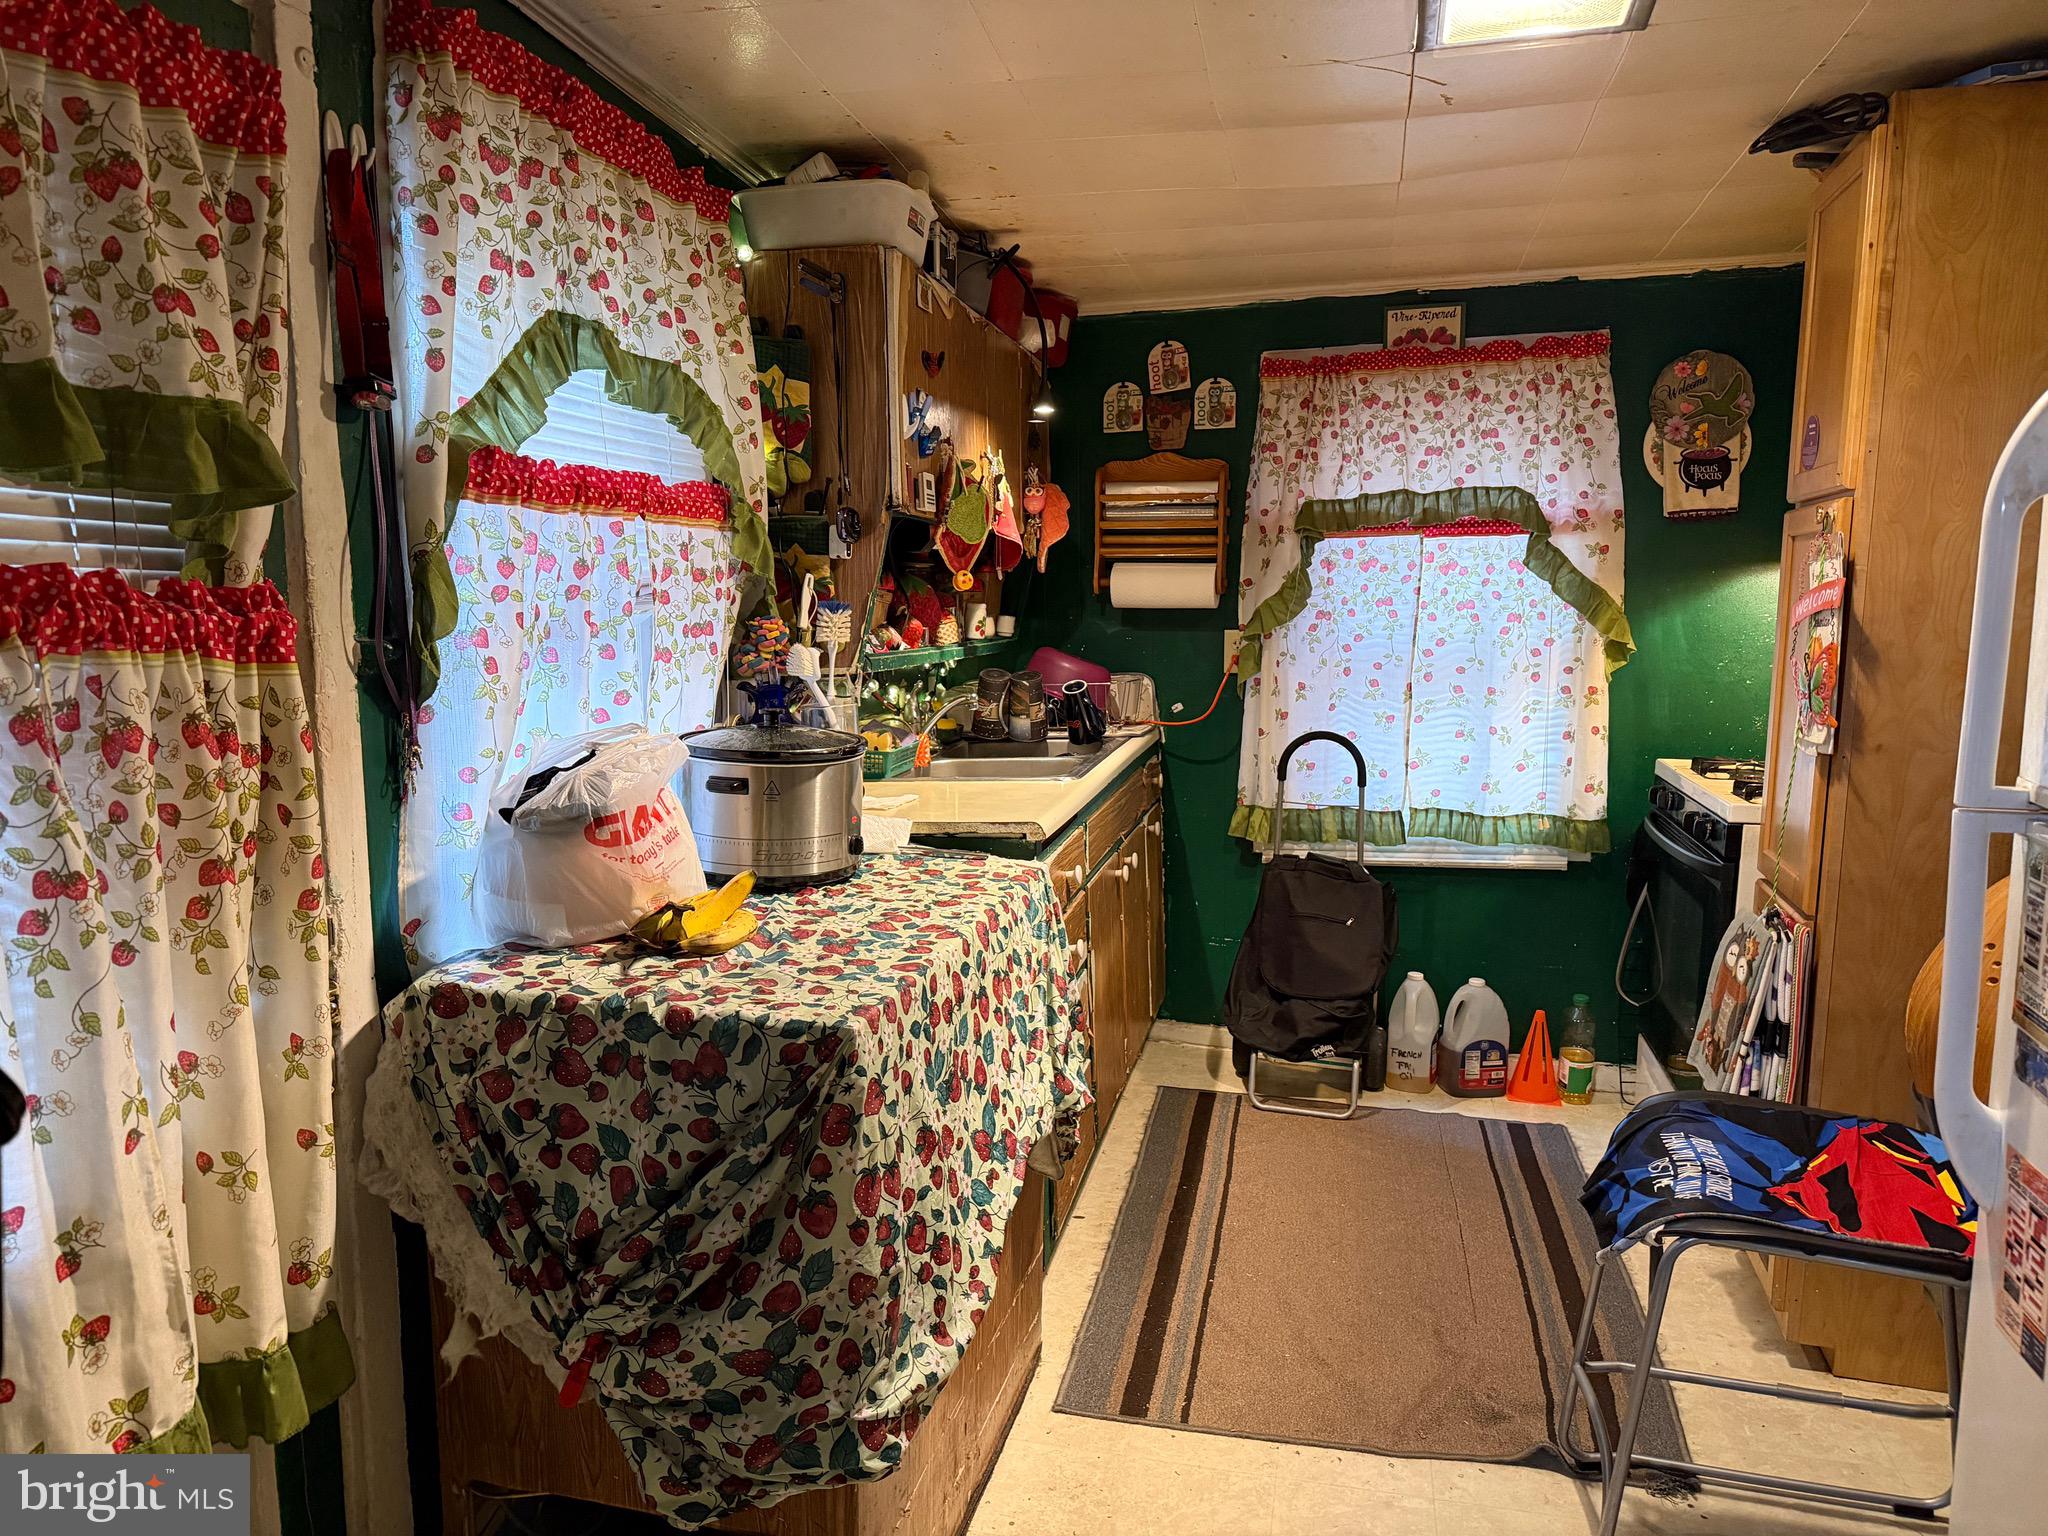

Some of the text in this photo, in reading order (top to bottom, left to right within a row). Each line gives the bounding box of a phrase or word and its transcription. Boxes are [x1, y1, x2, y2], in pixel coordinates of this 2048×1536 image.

[1391, 307, 1457, 323] Vine-Ripened
[1149, 360, 1161, 391] hoot
[1656, 377, 1708, 400] Welcome
[1104, 400, 1115, 429] hoot
[1195, 395, 1206, 426] hoot
[1689, 464, 1719, 474] HOCUS
[1695, 472, 1723, 482] POCUS
[1795, 586, 1839, 619] welcome
[752, 849, 825, 864] Snap-on
[1391, 1048, 1423, 1059] FRENCH
